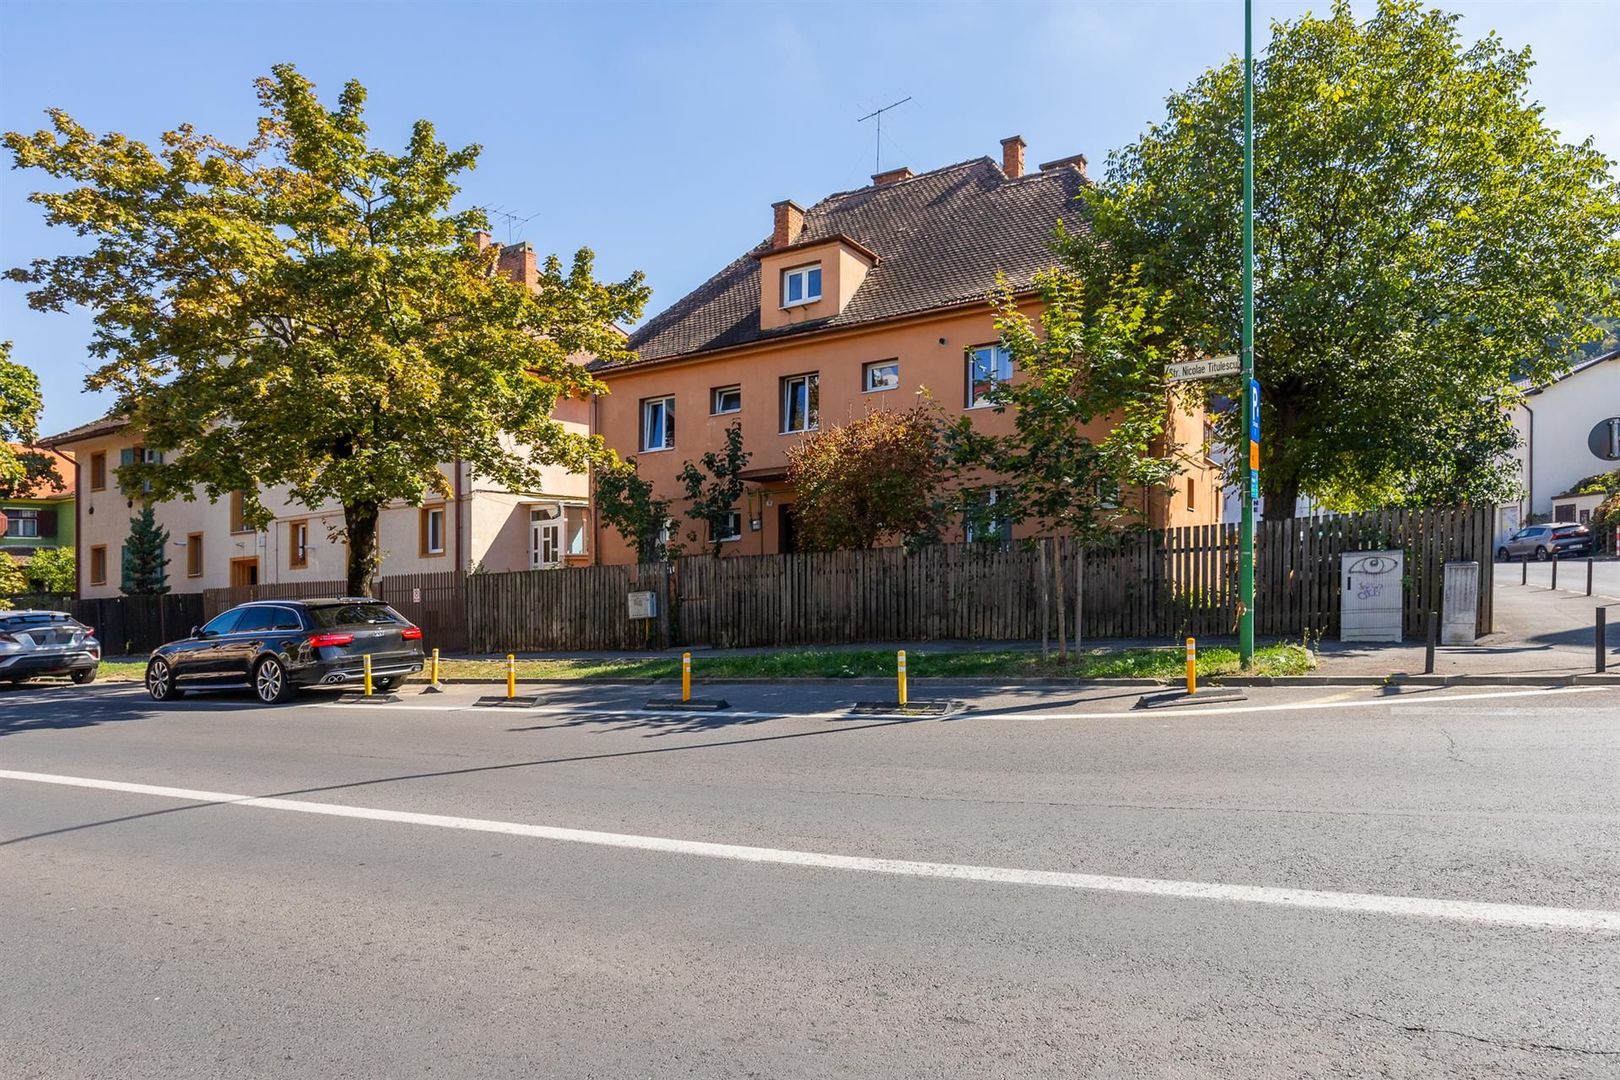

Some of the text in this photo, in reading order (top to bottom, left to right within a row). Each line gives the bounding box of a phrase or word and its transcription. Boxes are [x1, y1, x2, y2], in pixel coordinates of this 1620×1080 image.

[1182, 364, 1205, 376] Nicolae
[1207, 360, 1239, 373] Titulescu
[1252, 386, 1258, 421] P
